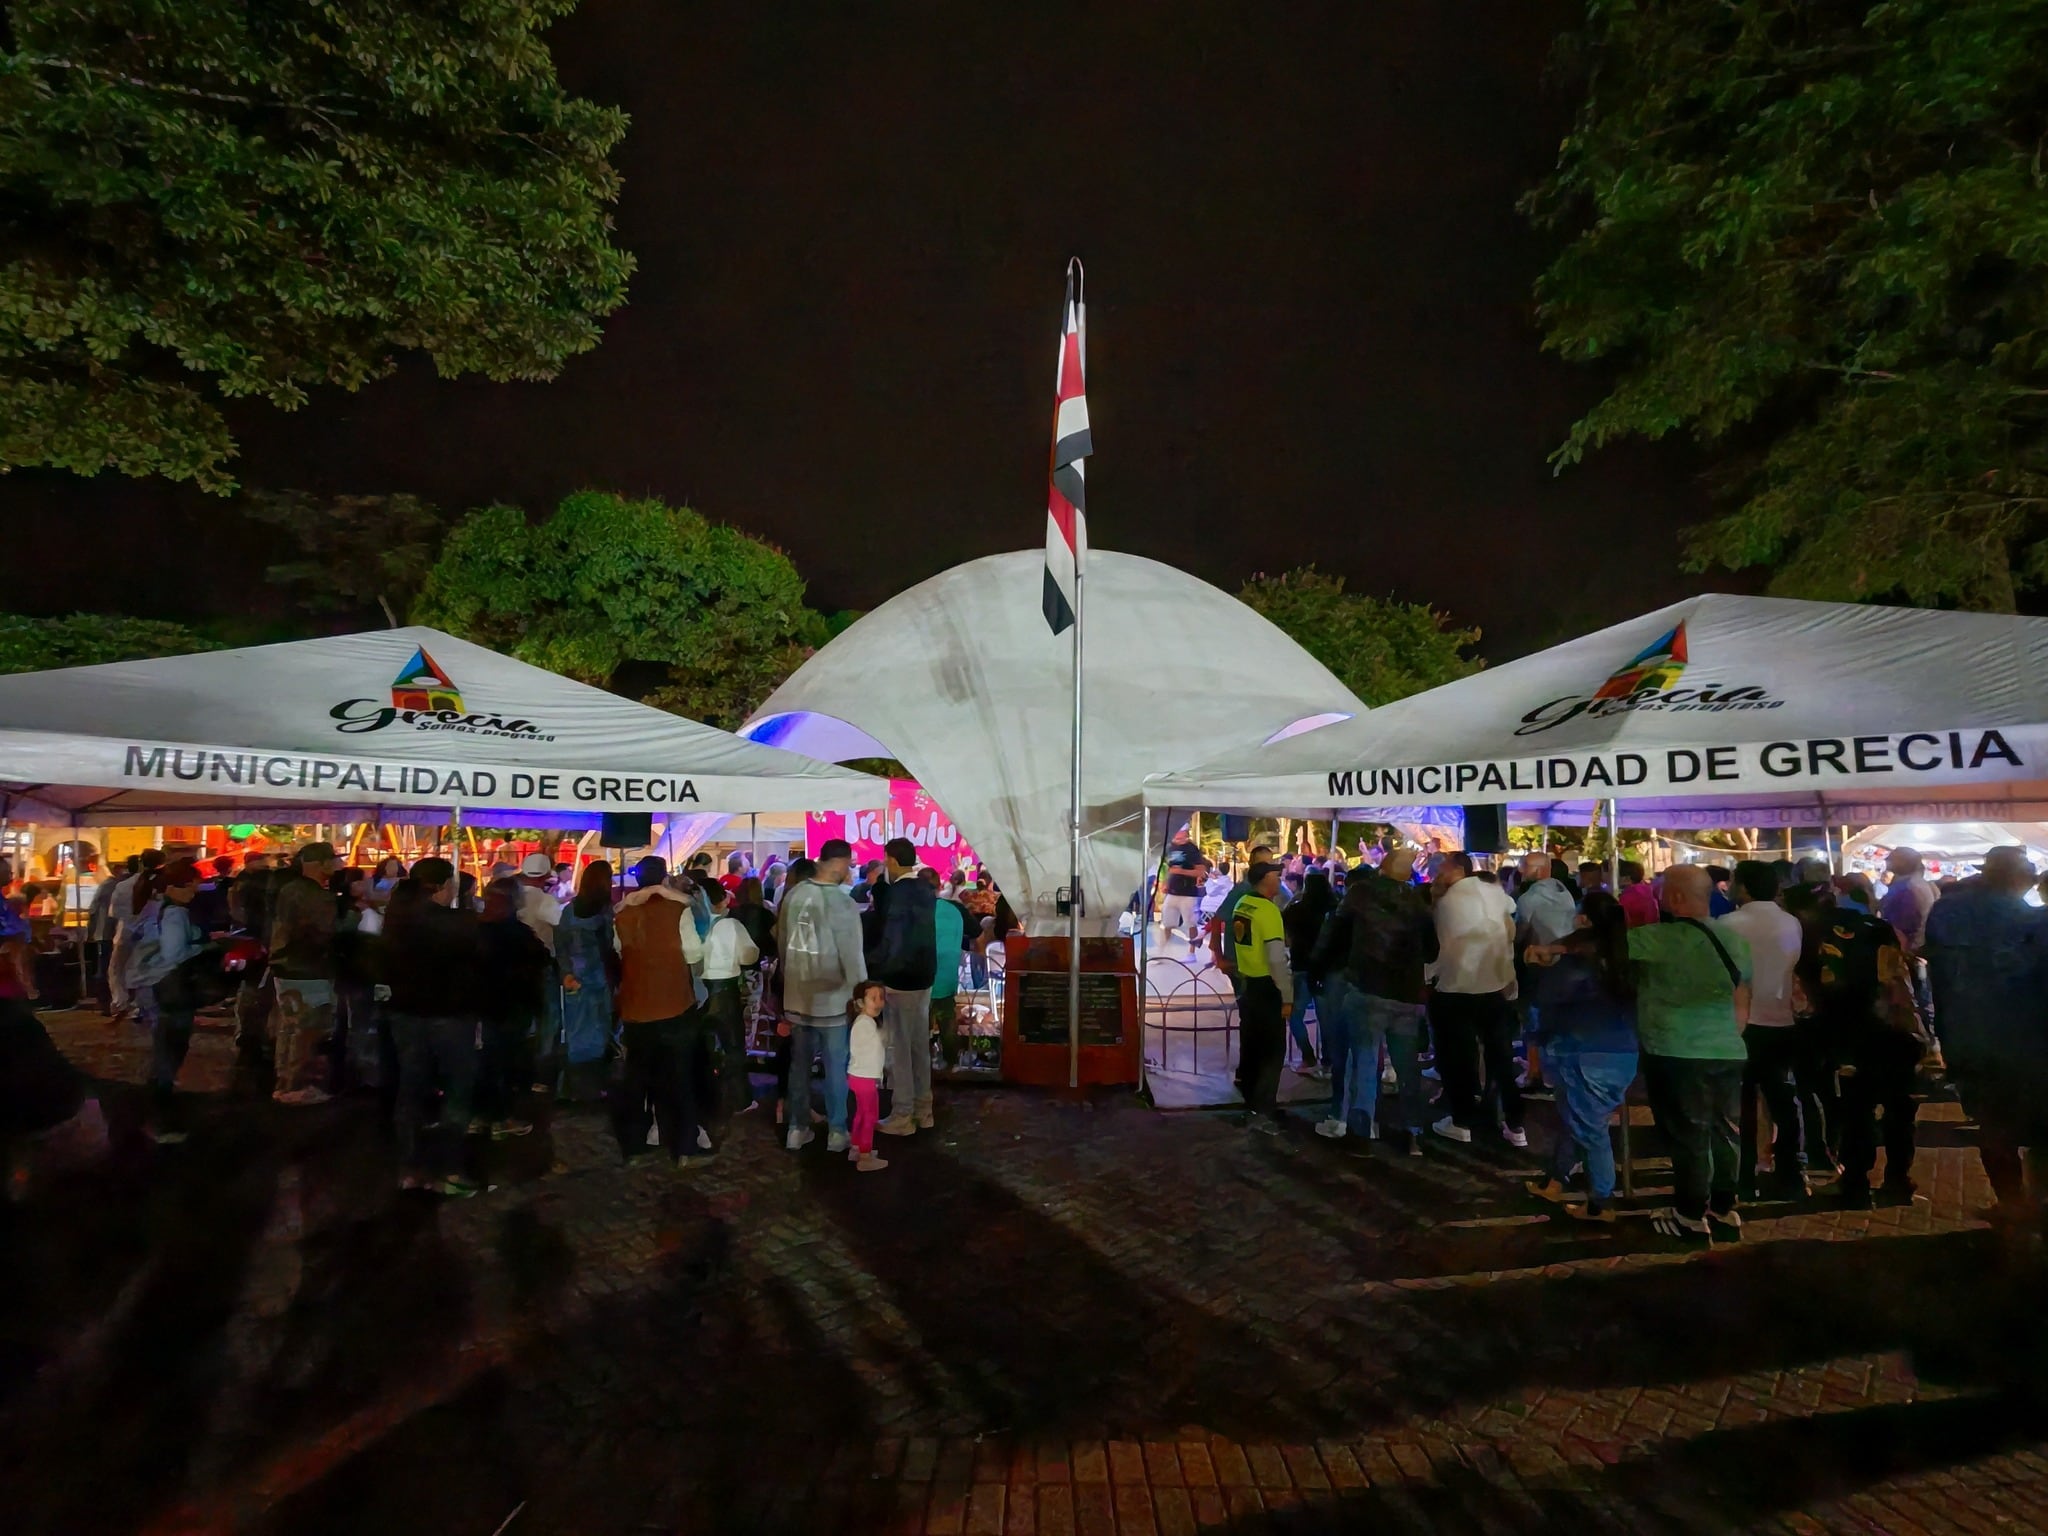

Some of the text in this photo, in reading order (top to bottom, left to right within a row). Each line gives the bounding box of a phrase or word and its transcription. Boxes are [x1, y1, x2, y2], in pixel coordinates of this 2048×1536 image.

[123, 745, 700, 803] MUNICIPALIDAD DE GRECIA
[1327, 729, 2025, 797] MUNICIPALIDAD DE GRECIA
[834, 808, 957, 848] Trululu
